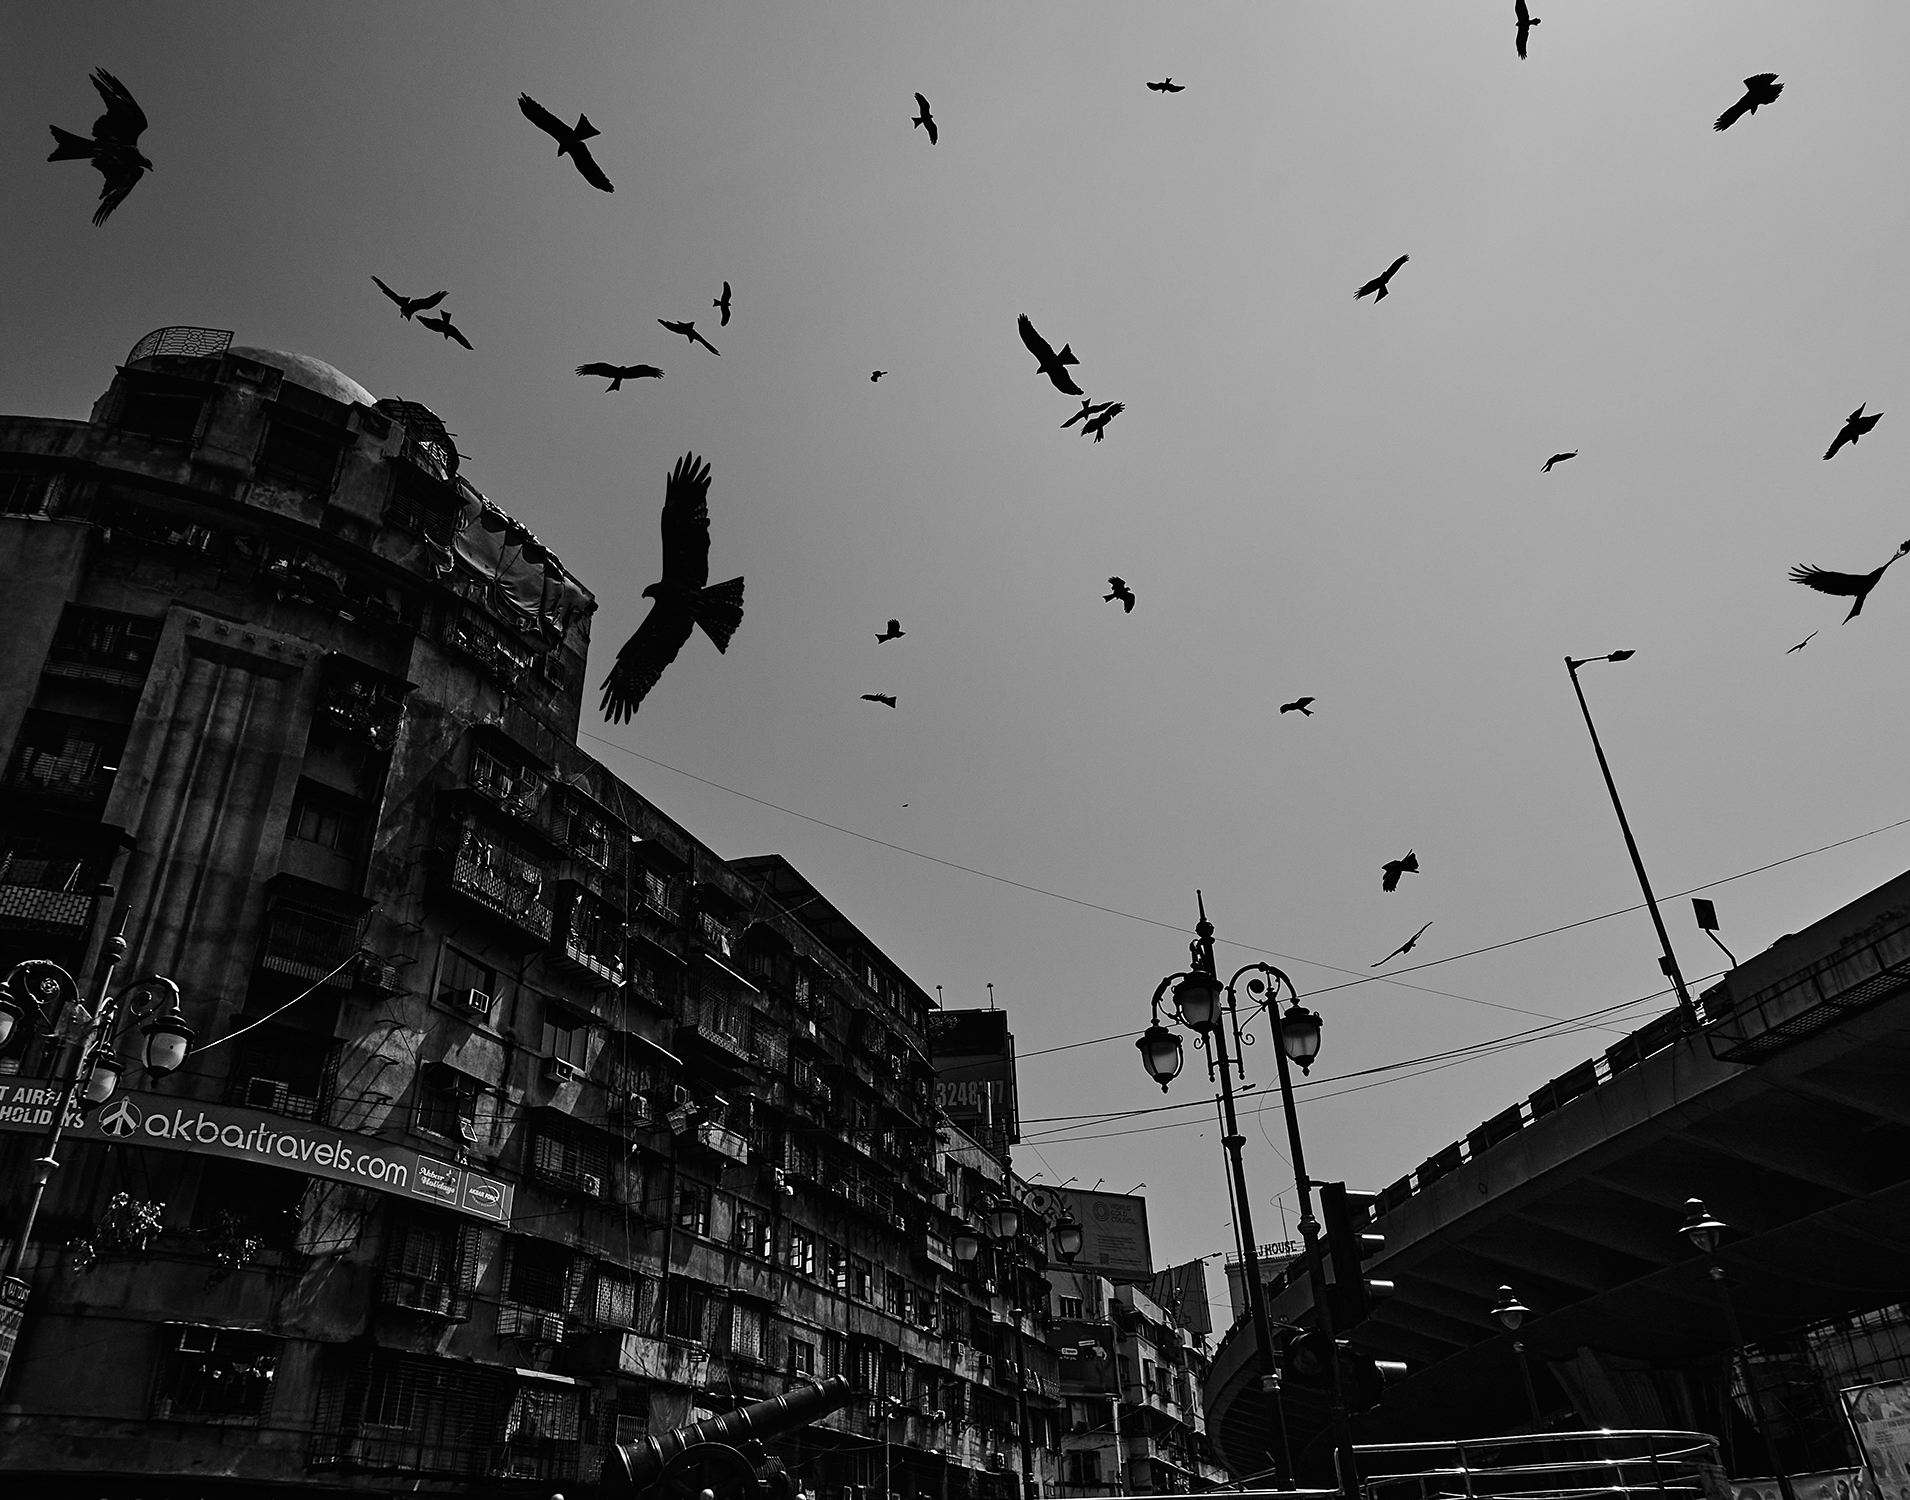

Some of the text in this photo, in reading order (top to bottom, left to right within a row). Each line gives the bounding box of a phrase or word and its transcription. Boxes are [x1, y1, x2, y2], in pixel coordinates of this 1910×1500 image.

[0, 1105, 85, 1129] HOLIDYS
[144, 1108, 408, 1188] akbartravels.com
[419, 1166, 445, 1181] Akbar
[420, 1175, 456, 1195] Holidays
[1109, 1203, 1131, 1211] WORLD
[1111, 1216, 1137, 1224] COUNCIL
[1264, 1240, 1297, 1256] HOUSE
